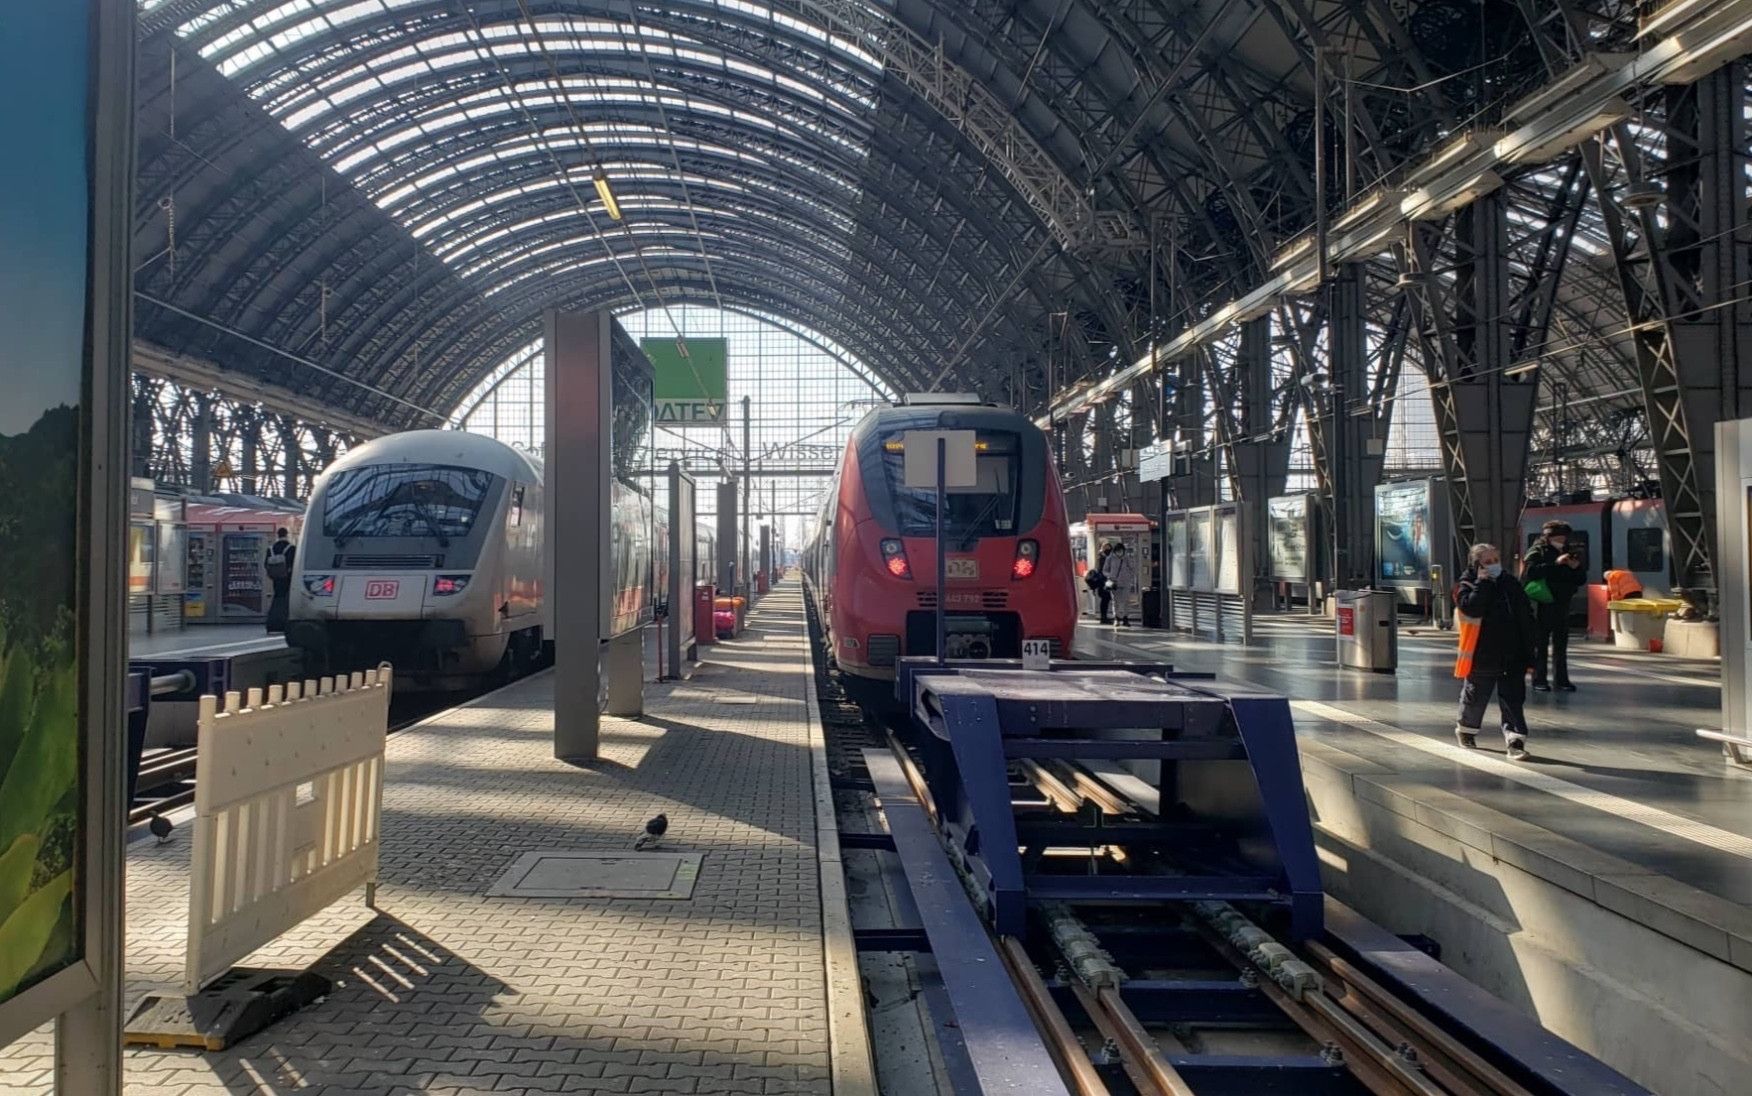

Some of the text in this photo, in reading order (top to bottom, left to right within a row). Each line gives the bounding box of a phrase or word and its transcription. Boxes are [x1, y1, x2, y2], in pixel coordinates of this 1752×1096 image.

[654, 402, 725, 421] ATEV
[369, 583, 395, 597] DB
[1024, 642, 1048, 656] 414
